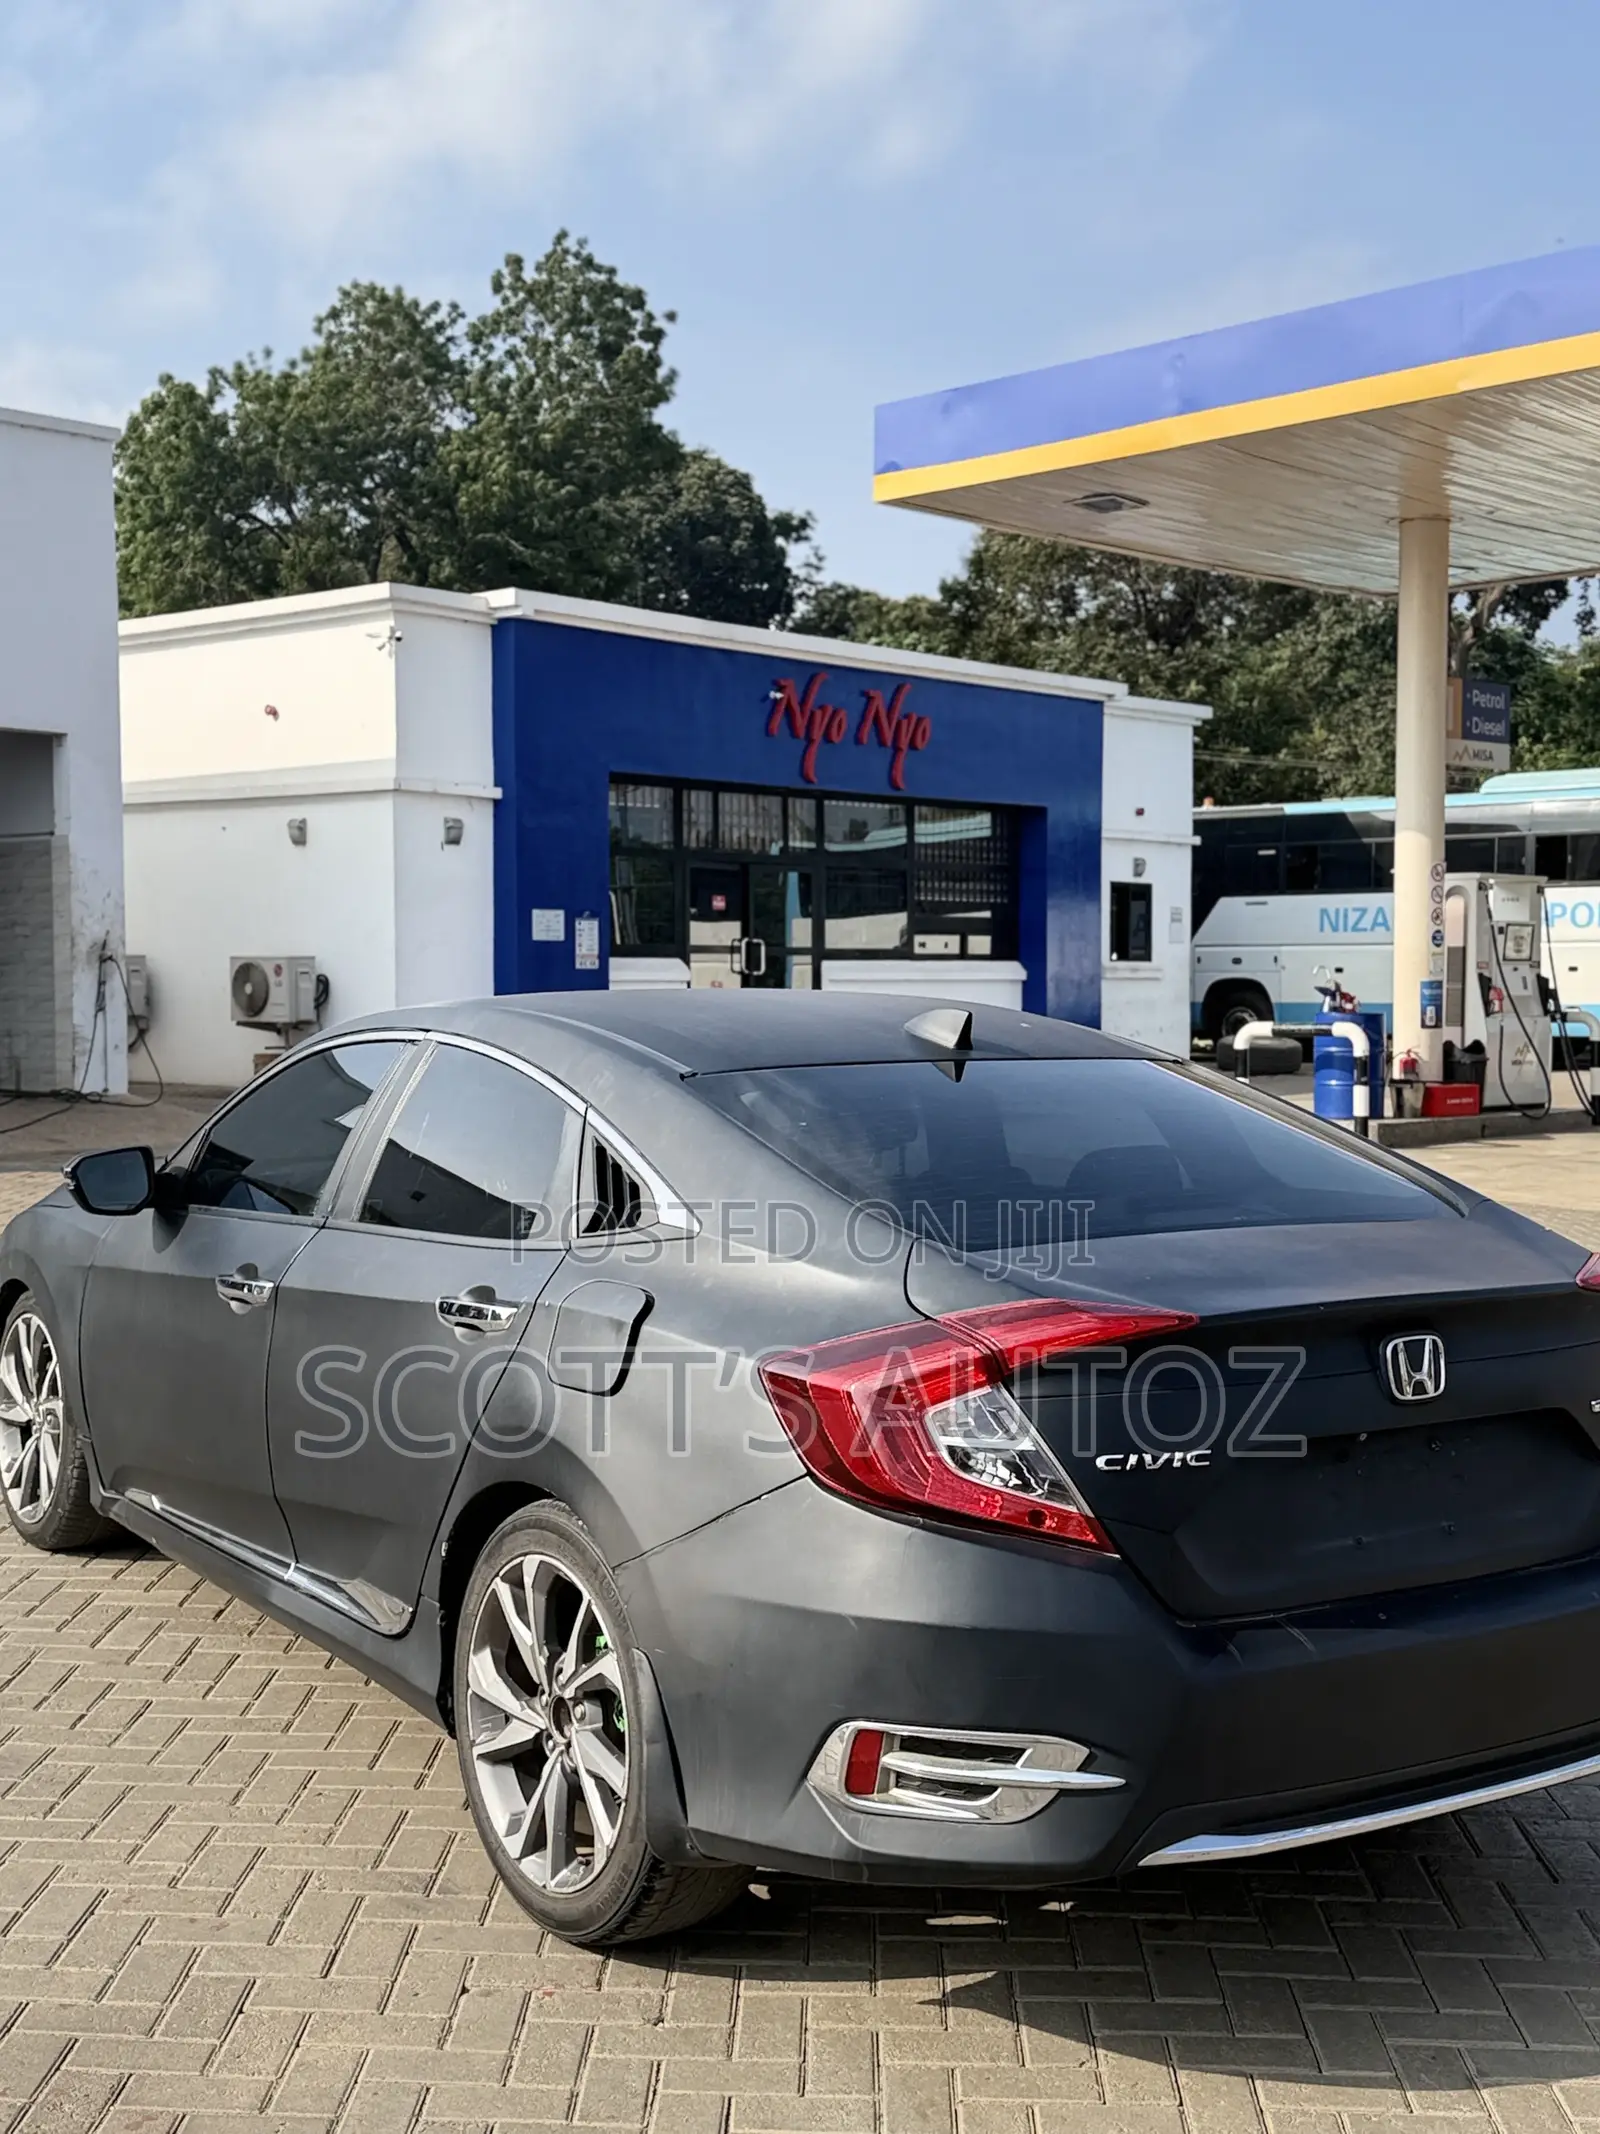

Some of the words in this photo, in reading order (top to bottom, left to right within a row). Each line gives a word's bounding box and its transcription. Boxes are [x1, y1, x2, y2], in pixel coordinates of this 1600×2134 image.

[1472, 689, 1505, 709] Petrol
[768, 672, 847, 784] Nyo
[857, 683, 931, 790] Nyo
[1472, 717, 1505, 736] Diesel
[1319, 907, 1391, 932] NIZA
[1548, 902, 1600, 928] PO
[1096, 1450, 1211, 1470] CIVIC
